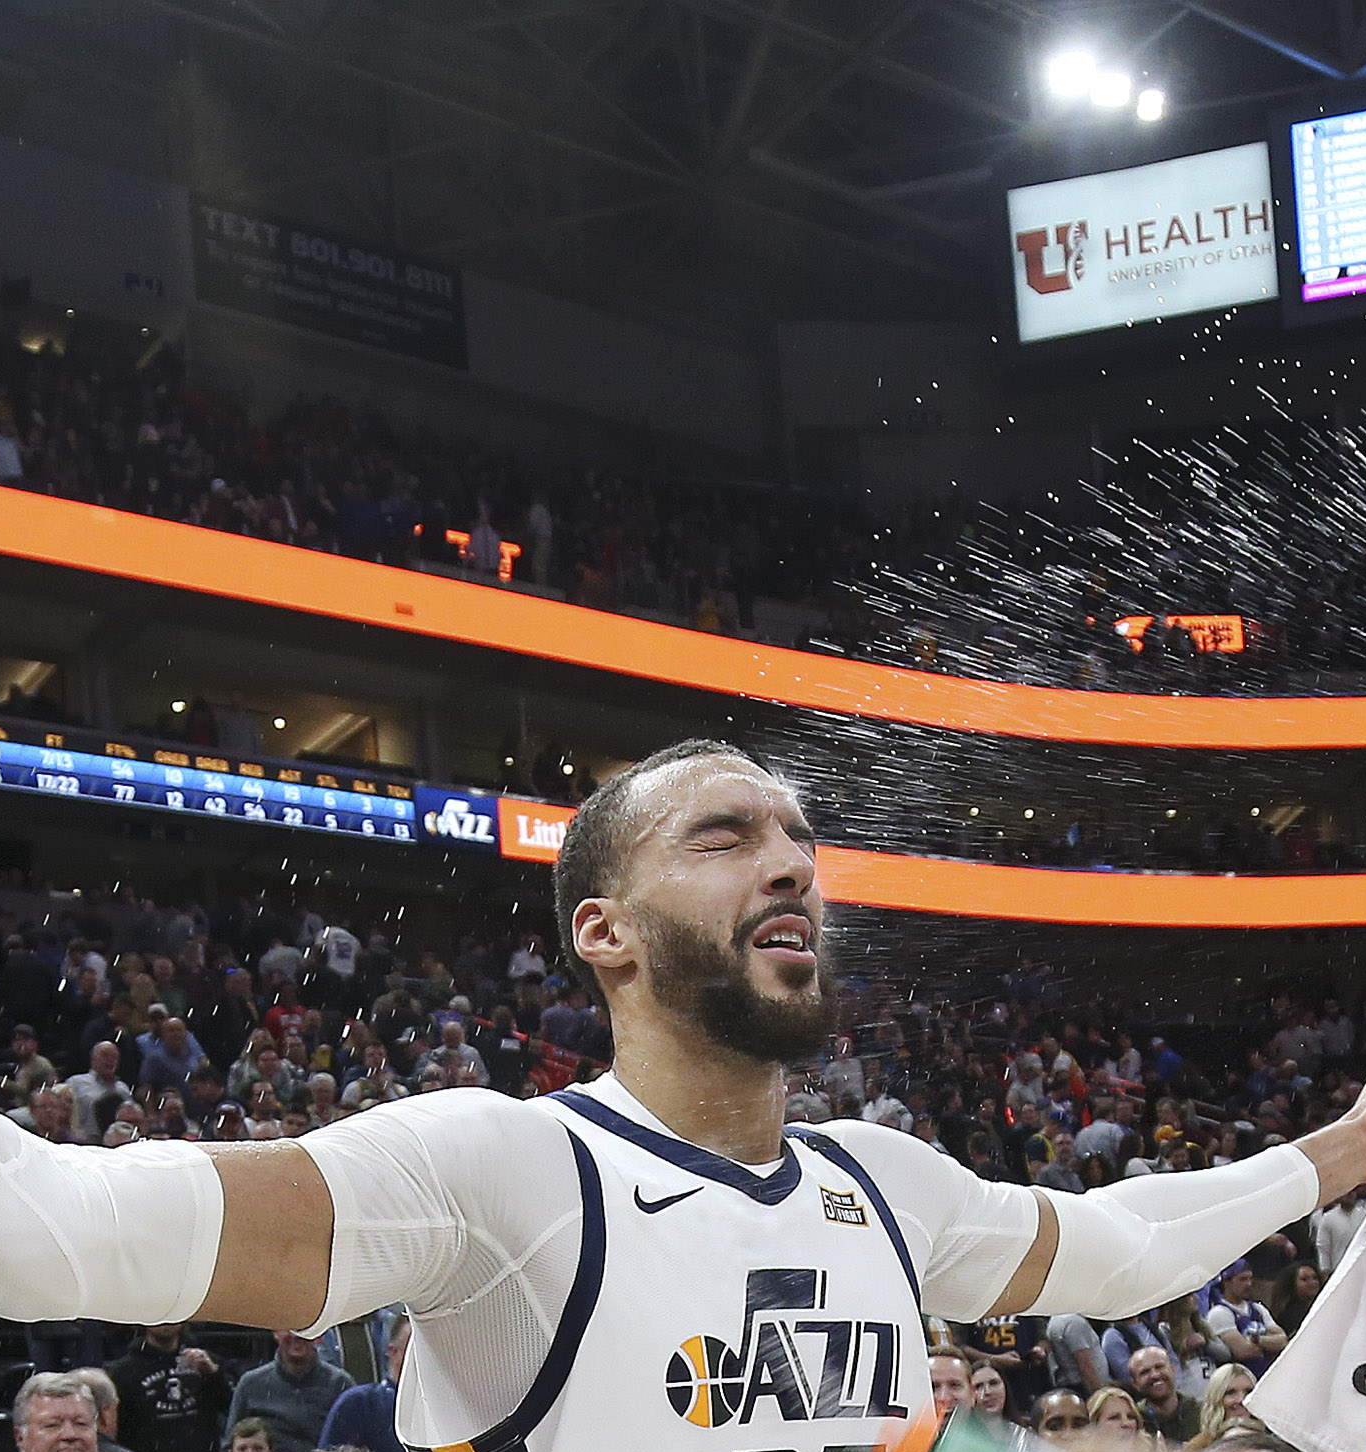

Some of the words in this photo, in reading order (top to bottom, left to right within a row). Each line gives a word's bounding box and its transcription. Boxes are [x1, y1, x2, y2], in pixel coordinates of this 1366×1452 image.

[202, 206, 280, 248] TEXT
[1105, 200, 1270, 260] HEALTH
[1107, 255, 1198, 283] UNIVERSITY
[1204, 250, 1224, 265] OF
[1230, 244, 1273, 261] UTAH
[36, 774, 80, 795] 17/22
[112, 784, 136, 802] 77
[166, 791, 184, 809] 12
[204, 796, 228, 815] 42
[282, 806, 304, 826] 22
[324, 814, 338, 831] 5
[361, 819, 375, 836] 6
[393, 823, 410, 840] 13
[821, 1190, 835, 1219] 5
[836, 1208, 863, 1223] FIGHT
[708, 1268, 909, 1425] JAZZ
[984, 1325, 1018, 1348] 45
